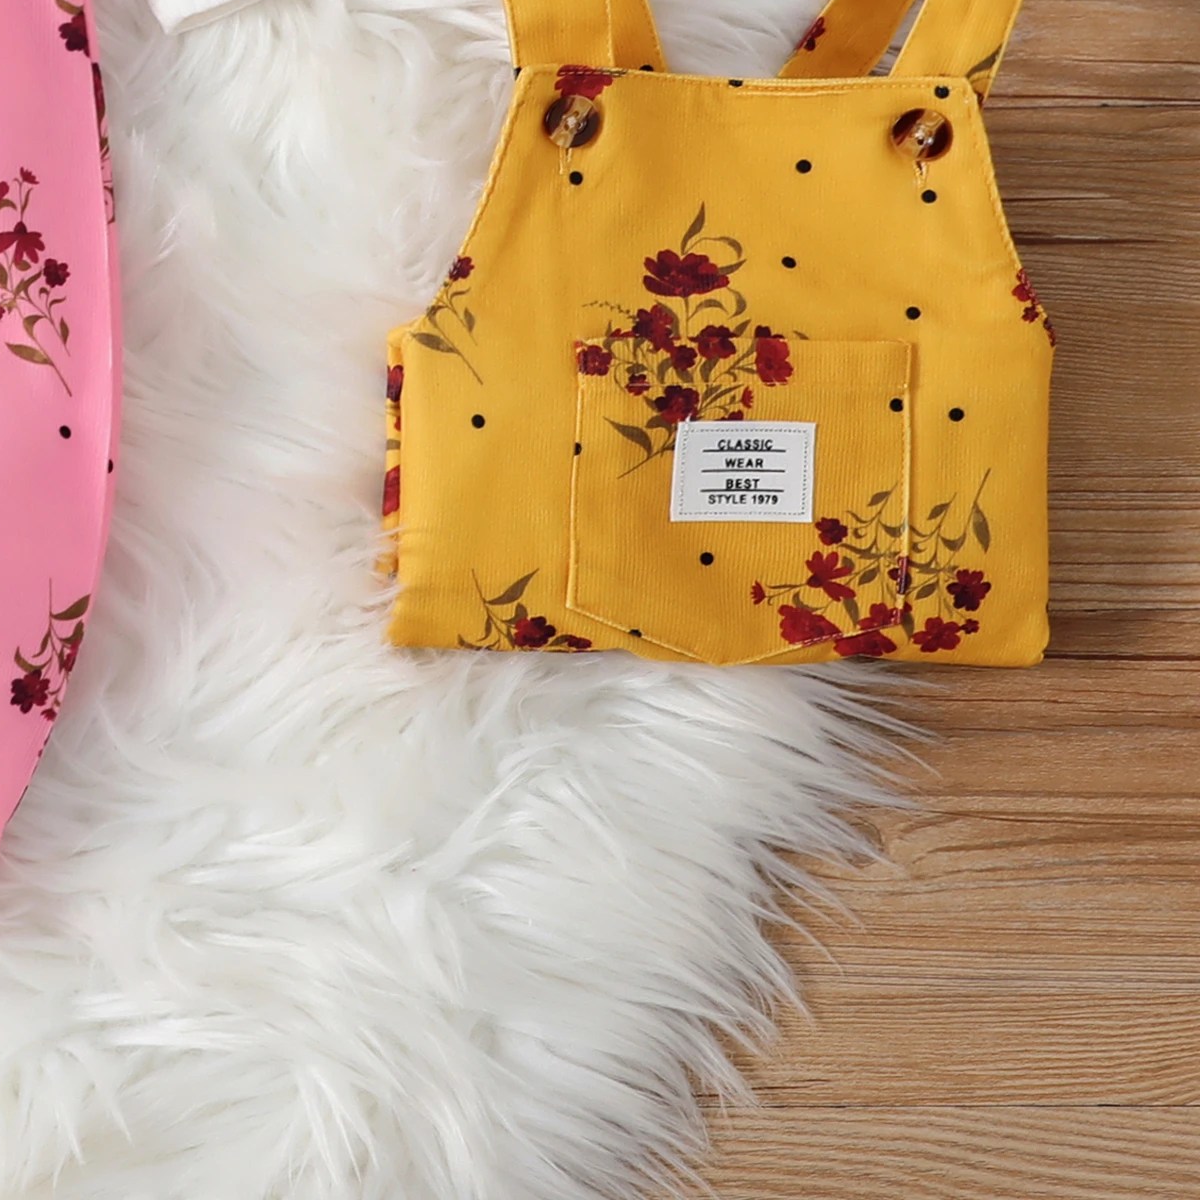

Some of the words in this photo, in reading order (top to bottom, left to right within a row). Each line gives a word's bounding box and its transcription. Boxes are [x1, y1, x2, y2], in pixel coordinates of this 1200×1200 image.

[717, 439, 774, 450] CLASSIC
[725, 458, 764, 468] WEAR
[725, 478, 761, 490] BEST
[707, 494, 747, 505] STYLE
[751, 495, 779, 505] 1979
